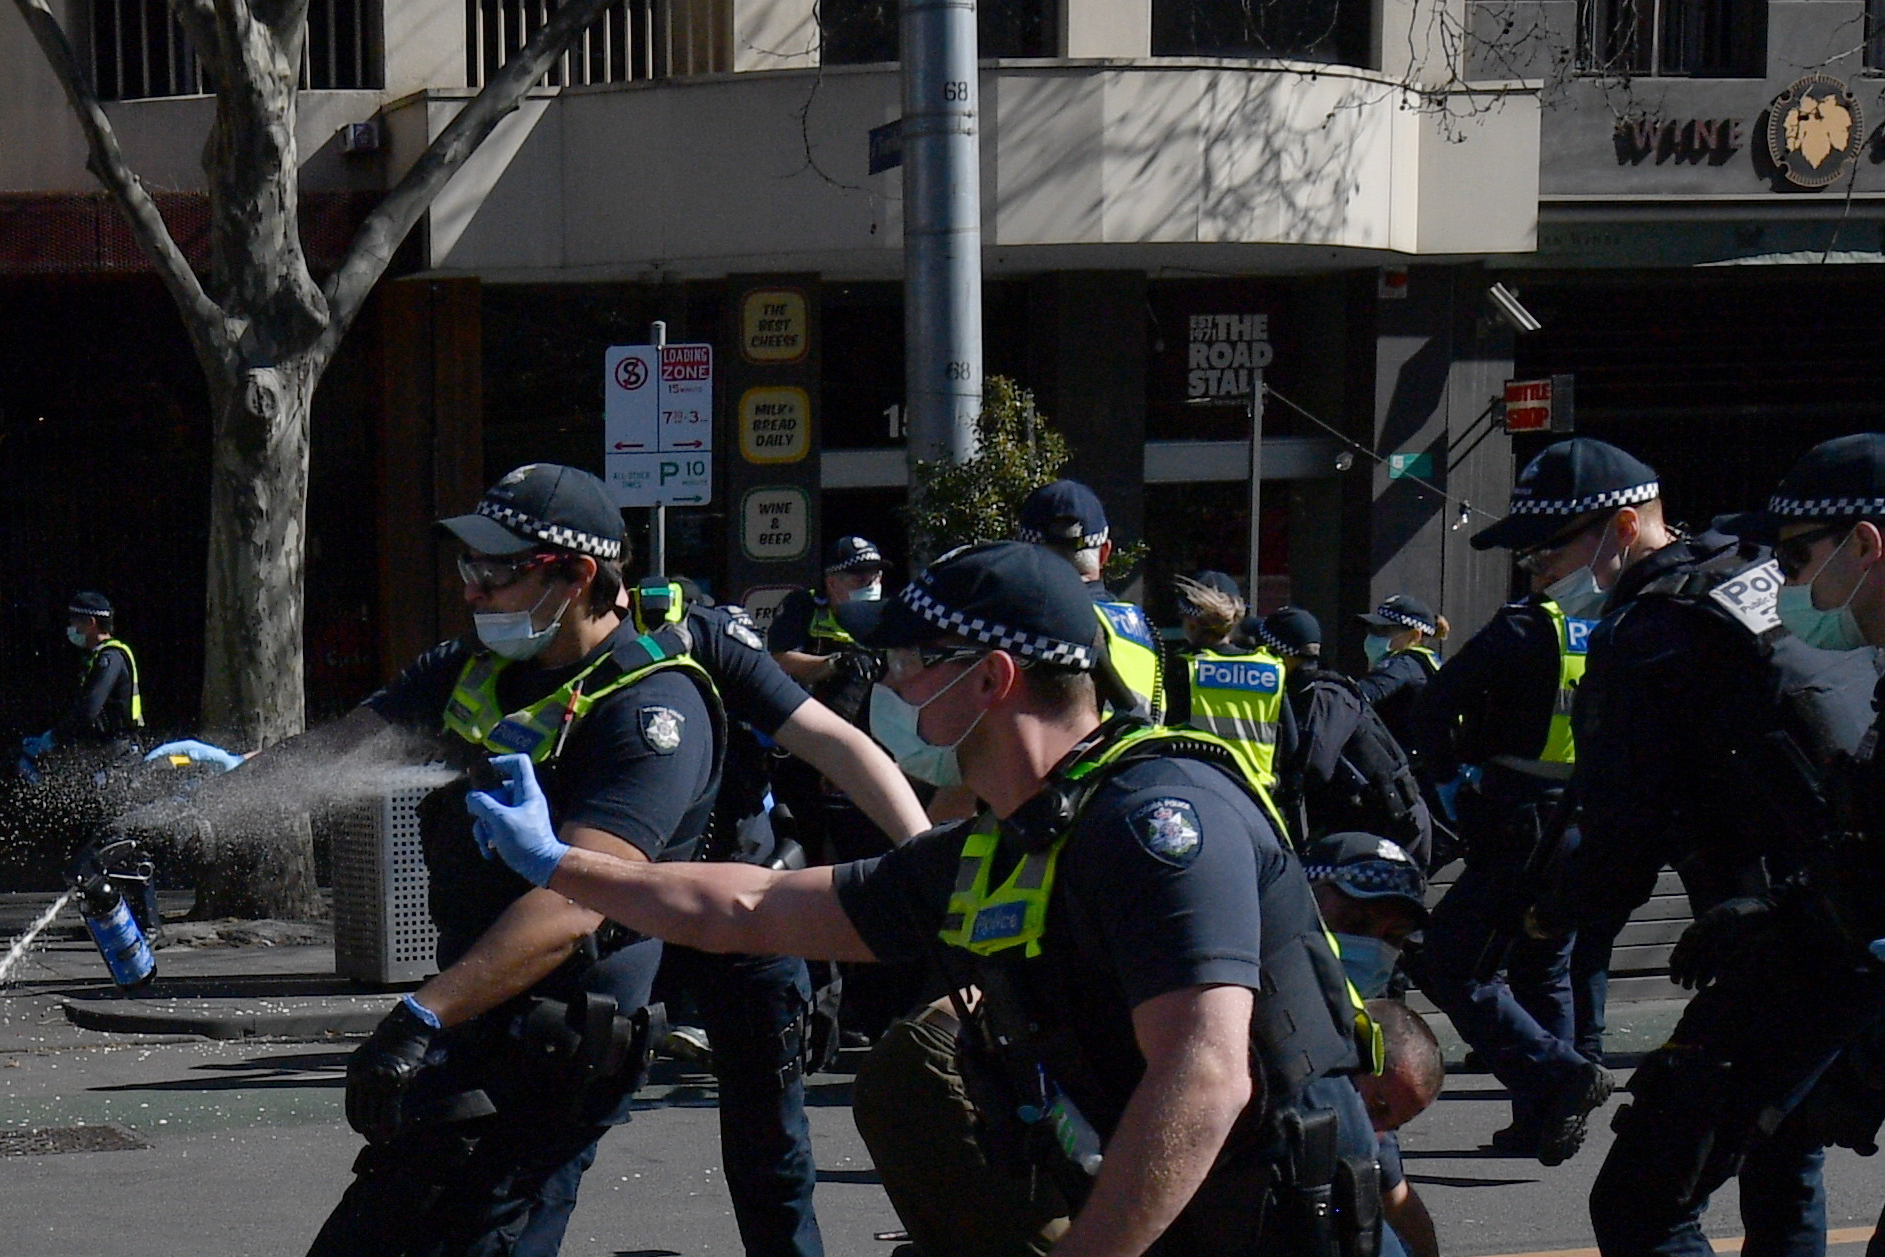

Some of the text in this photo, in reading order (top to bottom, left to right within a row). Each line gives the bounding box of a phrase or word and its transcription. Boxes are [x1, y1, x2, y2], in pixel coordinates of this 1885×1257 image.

[944, 81, 969, 101] 68
[1628, 117, 1744, 152] WINE
[763, 303, 788, 316] THE
[758, 319, 792, 332] BEST
[1214, 314, 1268, 341] THE
[751, 334, 799, 348] CHEESE
[663, 349, 707, 363] LOADING
[1188, 341, 1274, 369] ROAD
[663, 365, 709, 380] ZONE
[945, 361, 971, 380] 68
[668, 384, 680, 394] 15
[755, 404, 788, 416] MILK
[752, 418, 797, 431] BREAD
[756, 434, 794, 447] DAILY
[660, 460, 705, 486] P 10
[759, 502, 793, 515] WINE
[770, 518, 780, 530] &
[759, 532, 792, 545] BEER
[1197, 663, 1277, 688] Police
